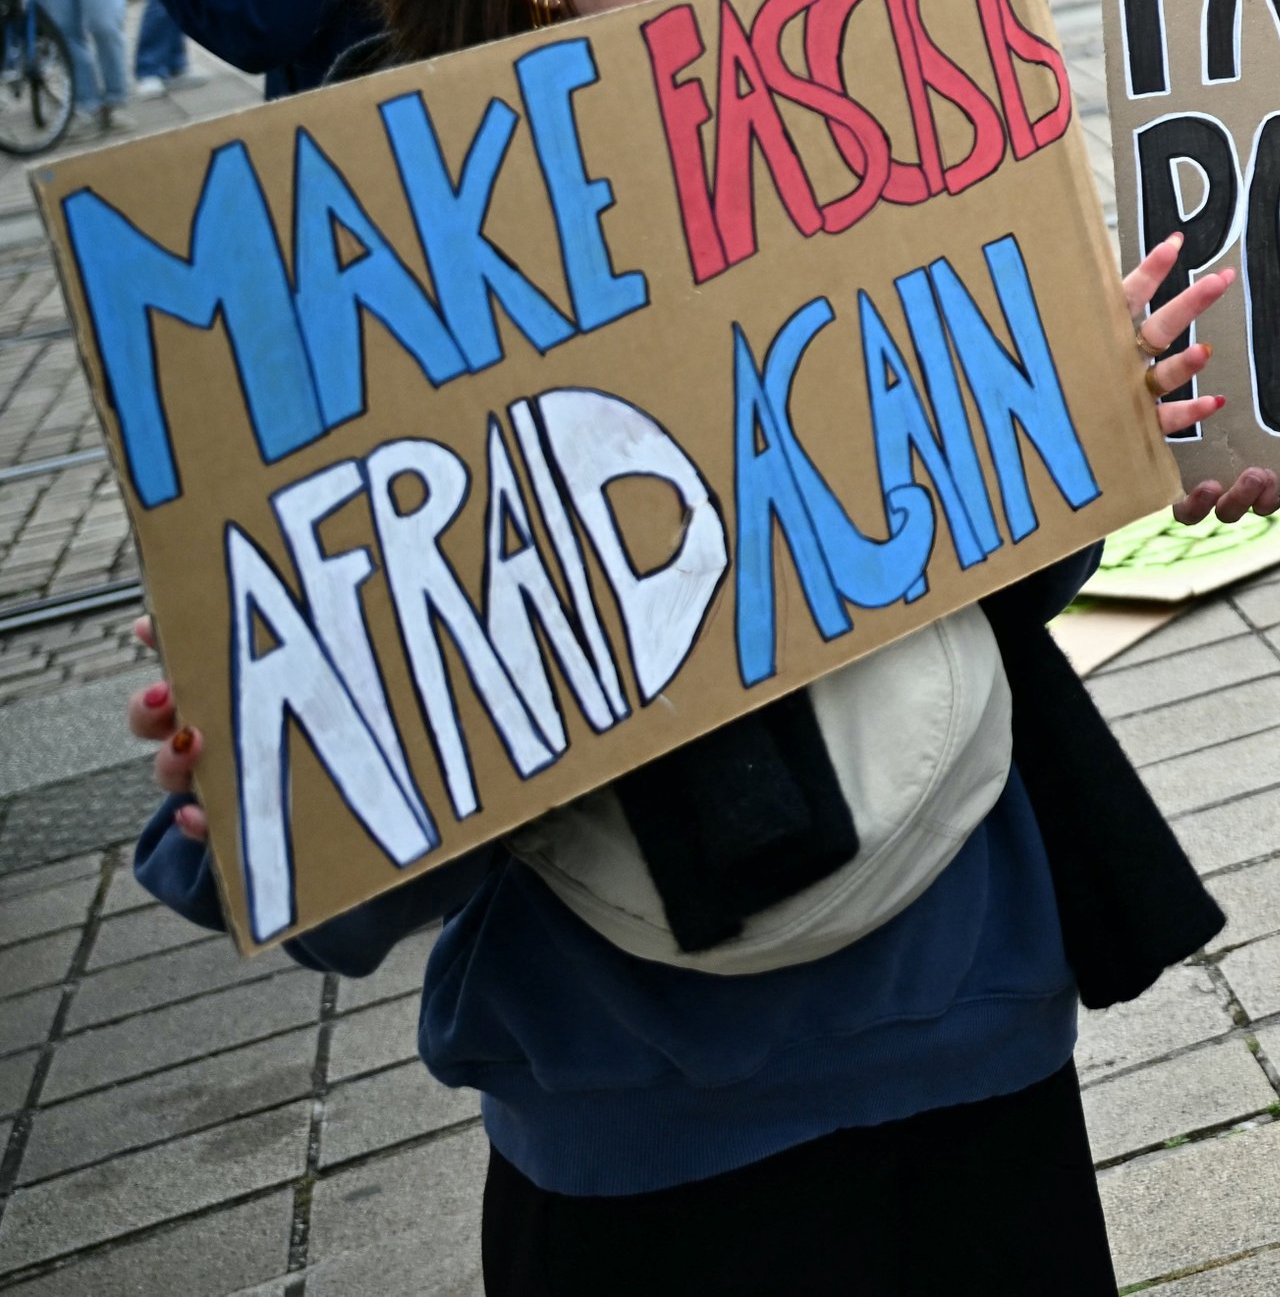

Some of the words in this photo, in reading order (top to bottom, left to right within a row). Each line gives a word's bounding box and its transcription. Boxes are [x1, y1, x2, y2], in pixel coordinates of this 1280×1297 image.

[61, 37, 649, 505] MAKE
[225, 385, 729, 944] AFRAID
[731, 233, 1102, 688] AGAIN
